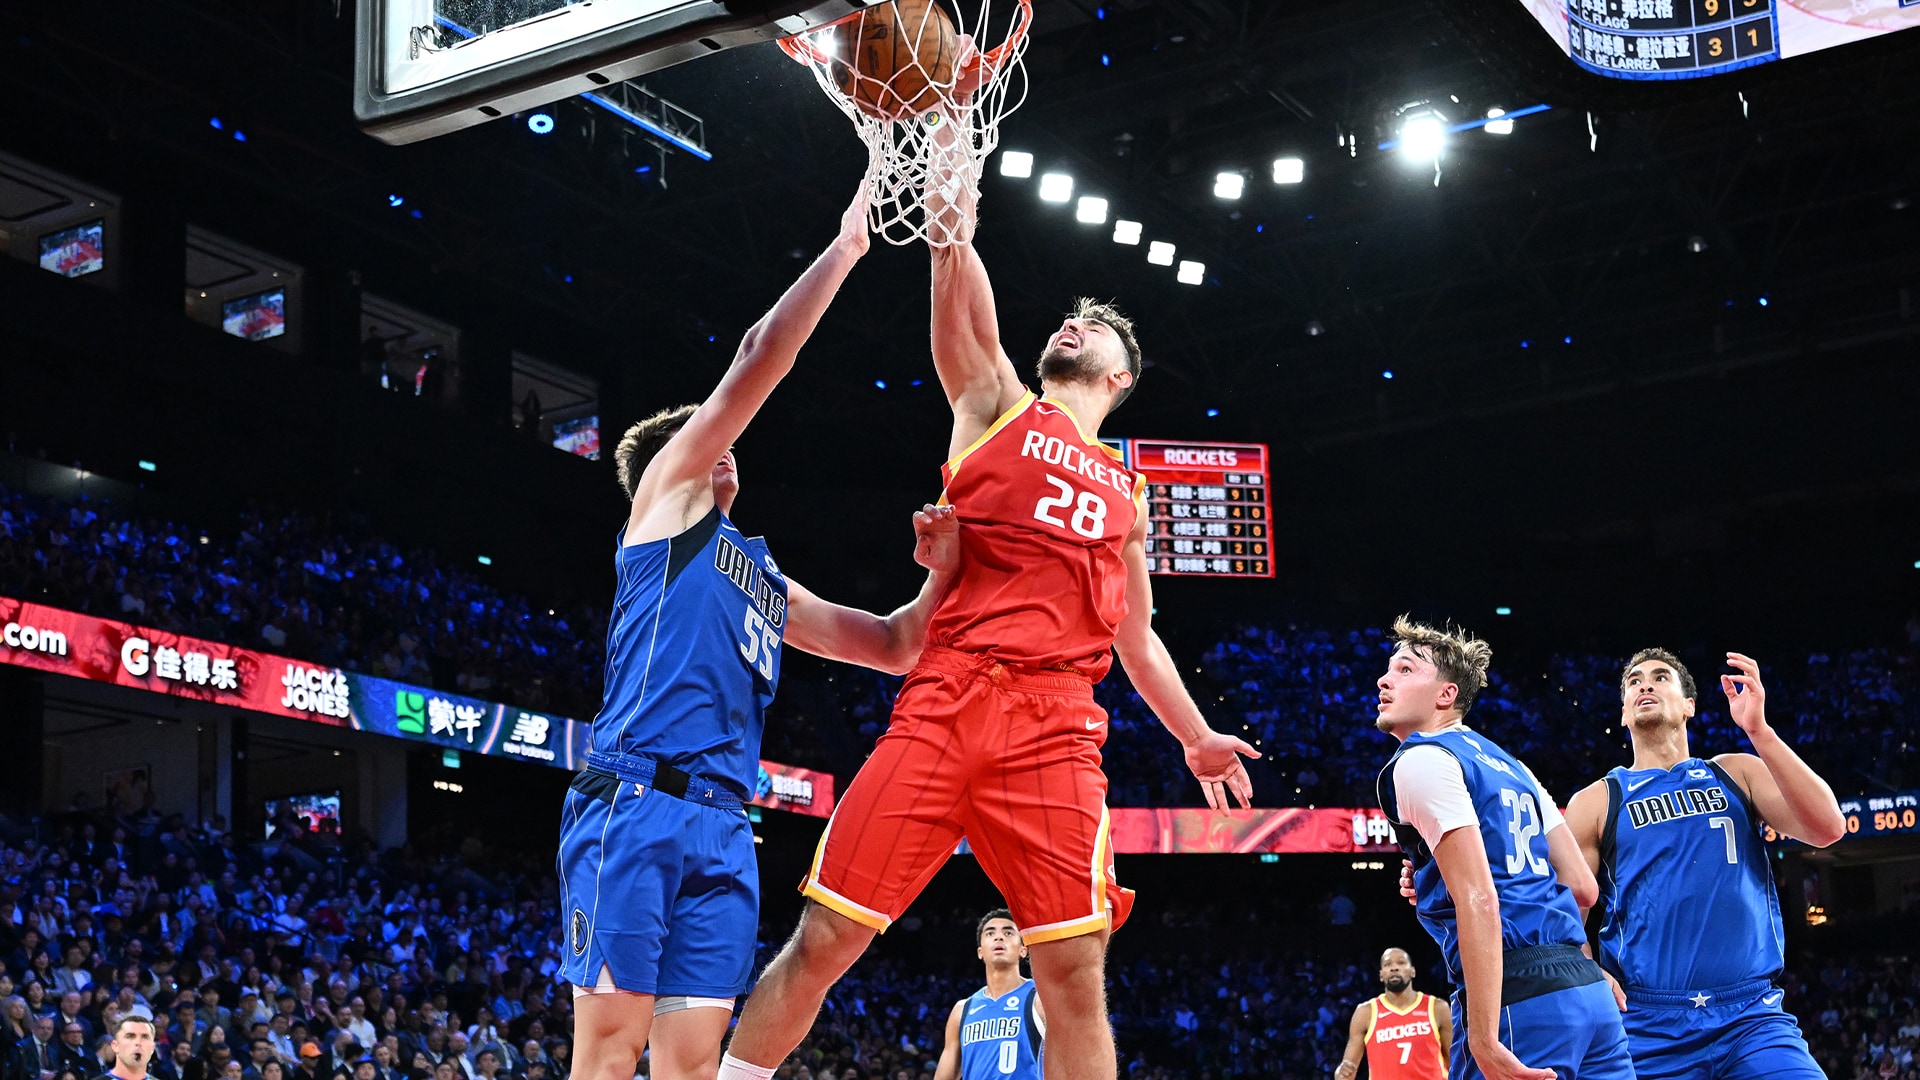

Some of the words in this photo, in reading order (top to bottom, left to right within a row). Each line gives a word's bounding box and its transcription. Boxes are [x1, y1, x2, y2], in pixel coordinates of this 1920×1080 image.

[1593, 12, 1630, 30] FLAGG
[1705, 0, 1719, 17] 9
[1708, 37, 1723, 57] 3
[1747, 28, 1758, 47] 1
[1595, 53, 1610, 67] DE
[1611, 56, 1661, 70] LARREA
[1021, 429, 1132, 500] ROCKETS
[1164, 448, 1238, 467] ROCKETS
[1033, 473, 1107, 539] 28
[1232, 489, 1240, 501] 9
[1252, 491, 1259, 502] 1
[1232, 507, 1241, 519] 4
[1233, 524, 1242, 536] 7
[1234, 542, 1243, 555] 2
[714, 533, 787, 629] DALLAS
[1235, 561, 1244, 573] 5
[1255, 562, 1264, 573] 2
[740, 603, 781, 681] 55
[153, 645, 238, 690] 佳得乐
[281, 663, 350, 698] JACK&
[281, 685, 350, 719] JONES
[428, 696, 482, 744] 蒙牛
[1626, 786, 1729, 830] DALLAS
[1874, 809, 1916, 831] 50.0
[1500, 787, 1550, 877] 32
[1708, 816, 1738, 865] 7
[963, 1017, 1021, 1046] DALLAS
[1375, 1021, 1431, 1043] ROCKETS
[998, 1040, 1018, 1074] 0
[1396, 1042, 1412, 1064] 7
